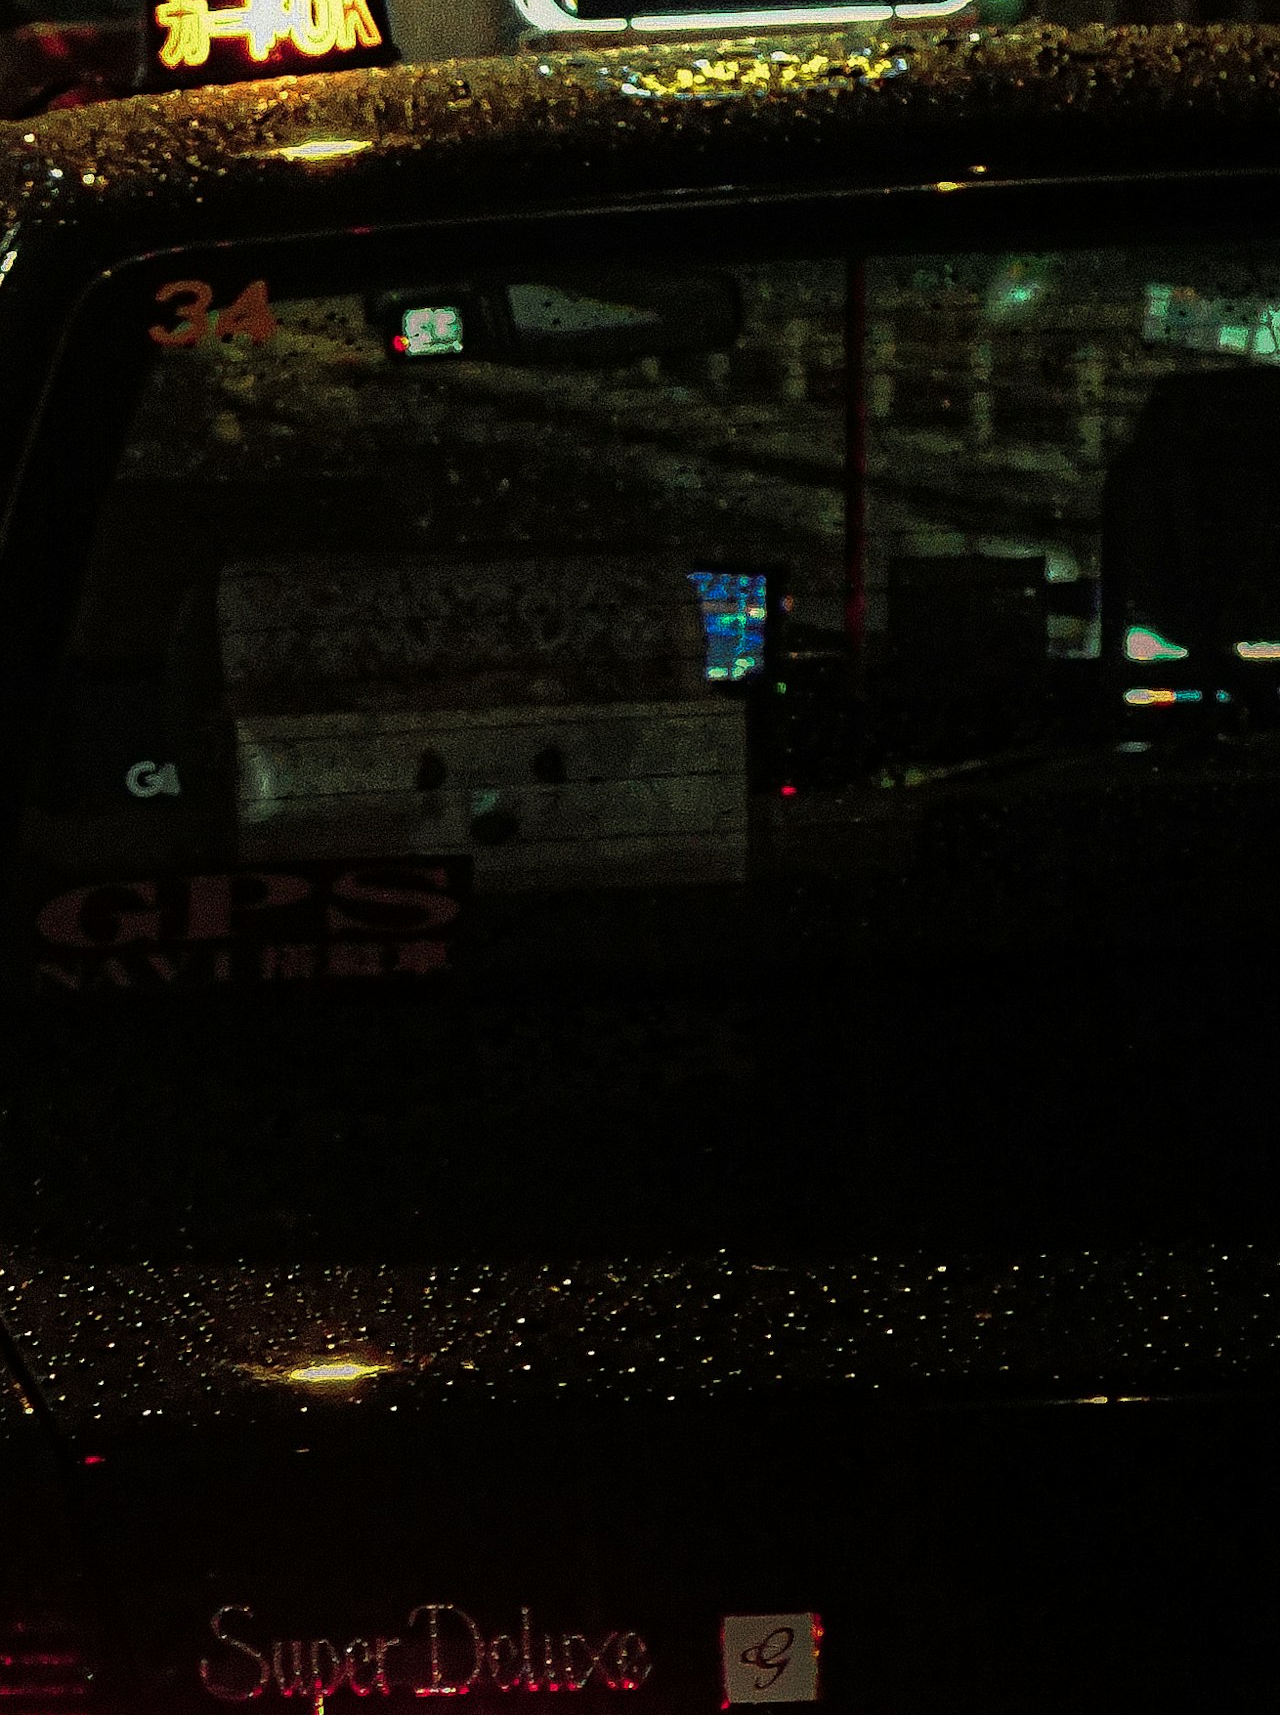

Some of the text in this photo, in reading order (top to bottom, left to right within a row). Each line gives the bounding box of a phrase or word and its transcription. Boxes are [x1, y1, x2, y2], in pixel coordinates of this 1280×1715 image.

[146, 277, 276, 347] 34
[35, 866, 461, 949] GPS
[408, 1602, 653, 1696] Deluxe
